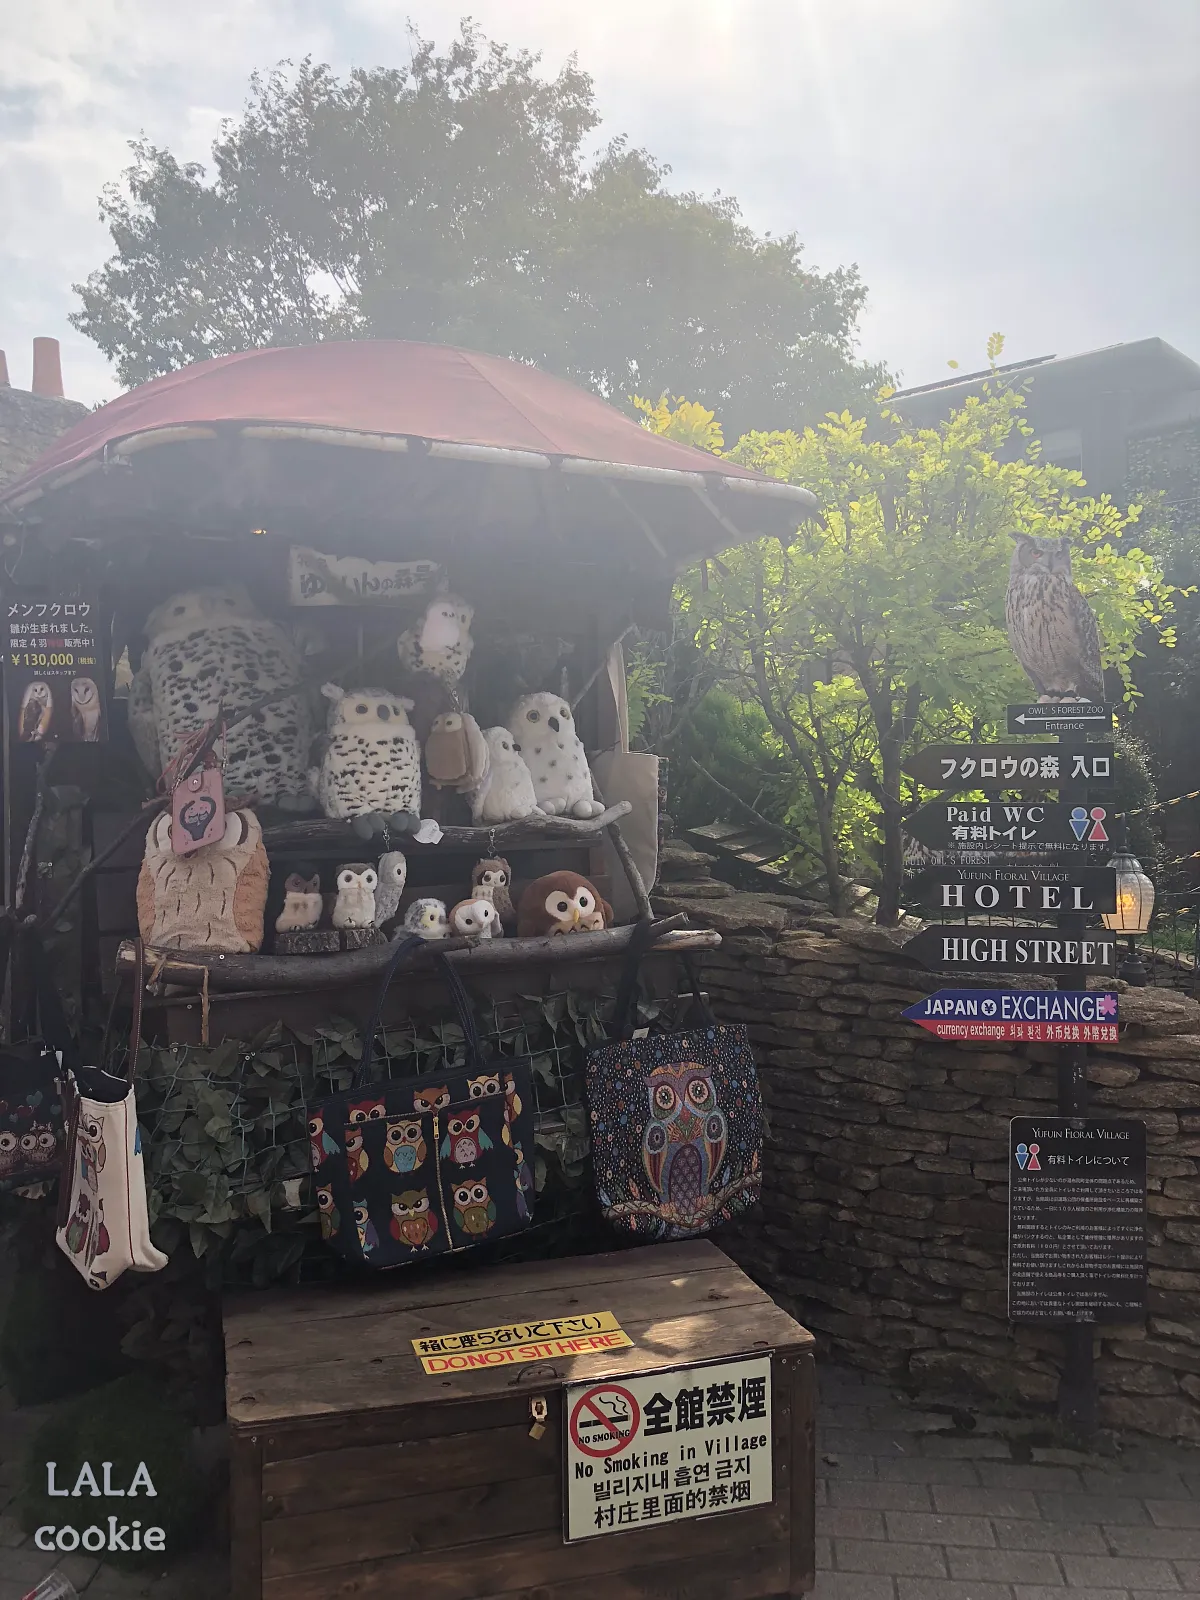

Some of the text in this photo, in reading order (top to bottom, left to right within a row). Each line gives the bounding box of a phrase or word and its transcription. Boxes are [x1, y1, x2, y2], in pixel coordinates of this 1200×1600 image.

[7, 602, 91, 617] メンフクロウ
[1056, 705, 1085, 715] FOREST
[1086, 705, 1104, 714] ZOO
[1045, 721, 1085, 731] Entrance
[940, 755, 1110, 779] フクロウの森 入口
[946, 806, 1045, 823] Paid WC
[952, 825, 1037, 842] 有料トイレ
[960, 855, 992, 865] FOREST
[941, 884, 1093, 911] HOTEL
[941, 937, 1114, 966] HIGH STREET
[924, 999, 978, 1016] JAPAN
[1001, 995, 1106, 1021] EXCHANGE
[936, 1023, 969, 1040] currency
[970, 1024, 1006, 1040] exchange
[1047, 1154, 1130, 1166] 有料トイレについて
[419, 1316, 602, 1352] 箱に座らないで下さい
[642, 1375, 767, 1437] 全館禁煙
[578, 1429, 631, 1445] NO SMOKING
[575, 1432, 768, 1479] No Smoking in Village
[592, 1455, 751, 1502] 빌리지내 흡연 금지
[593, 1480, 752, 1529] 村庄里面的禁烟
